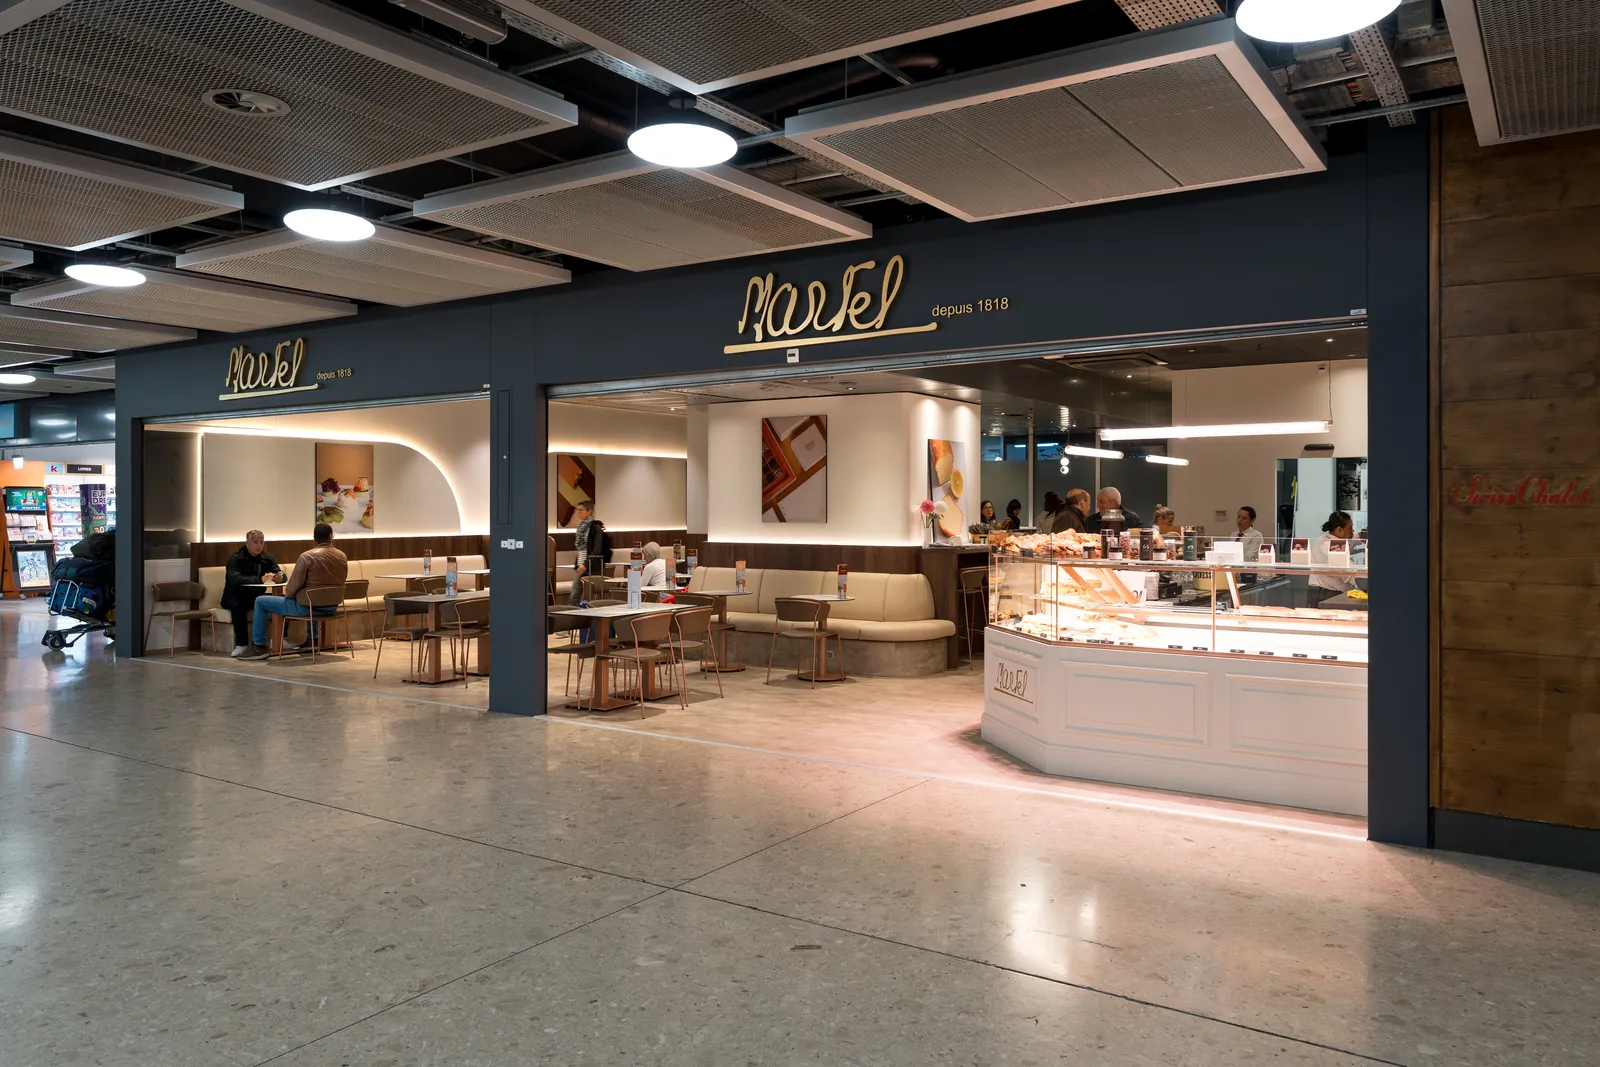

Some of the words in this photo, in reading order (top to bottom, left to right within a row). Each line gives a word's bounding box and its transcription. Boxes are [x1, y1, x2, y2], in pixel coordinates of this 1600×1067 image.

[932, 302, 973, 318] depuis
[977, 297, 1009, 313] 1818
[316, 370, 336, 380] depuis
[337, 368, 352, 378] 1818
[1518, 475, 1591, 505] Chalet
